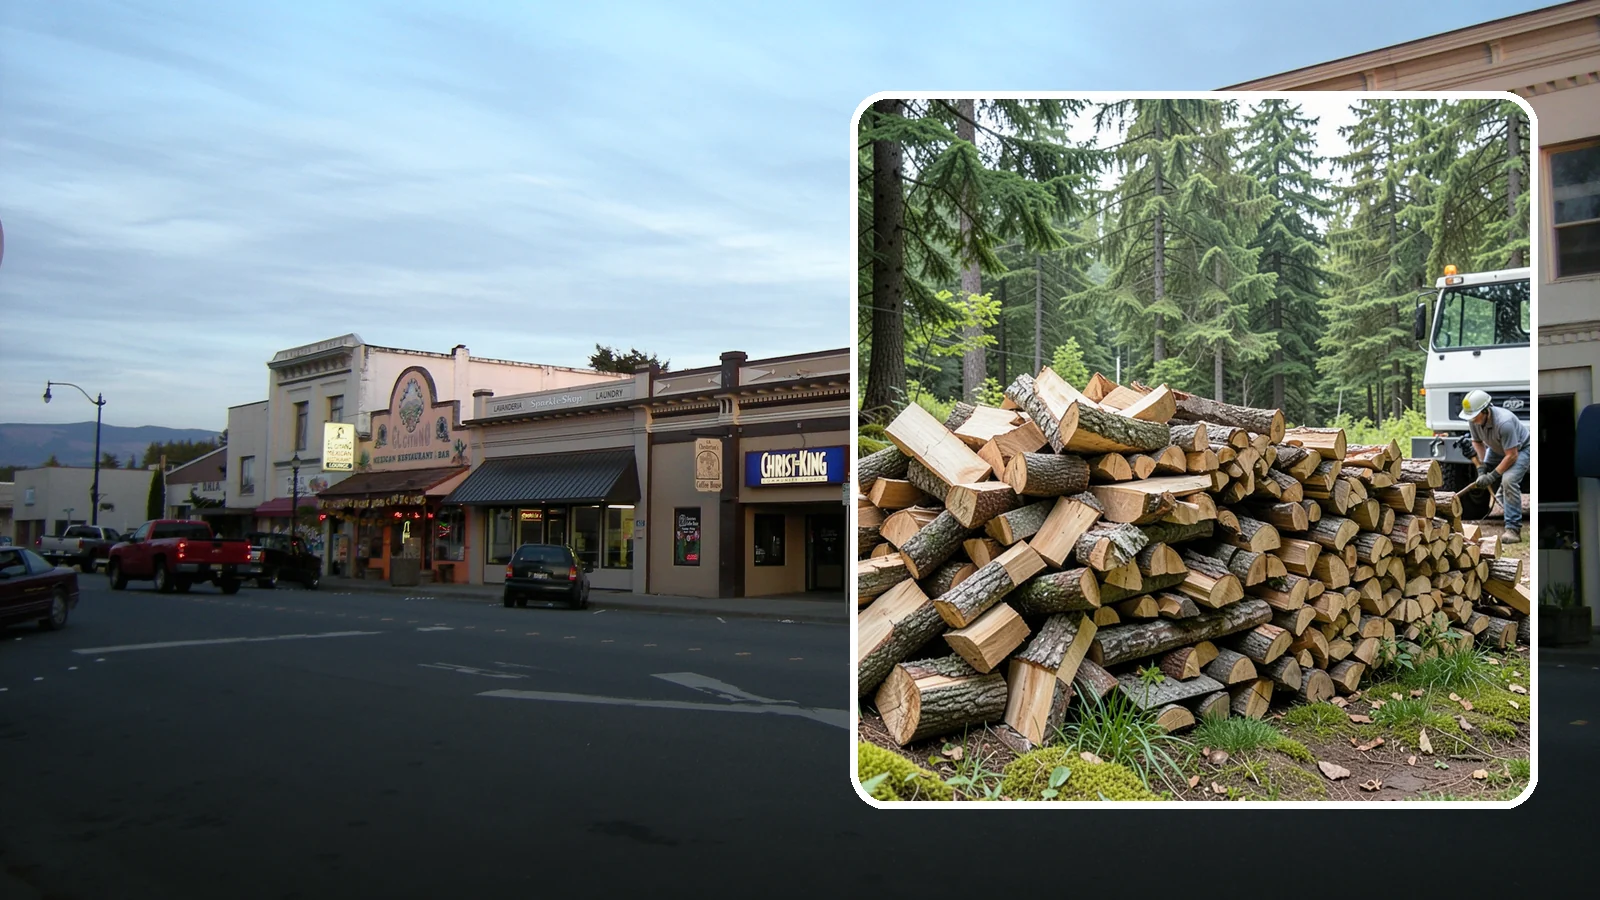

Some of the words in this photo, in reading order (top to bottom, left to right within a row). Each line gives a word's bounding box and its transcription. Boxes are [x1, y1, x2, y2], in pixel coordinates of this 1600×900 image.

[494, 402, 522, 412] LAVANDERIA
[562, 393, 582, 405] Shop
[595, 389, 623, 400] LAUNDRY
[373, 454, 397, 464] MEXICAN
[397, 451, 434, 462] RESTAURANT
[437, 450, 450, 459] BAR
